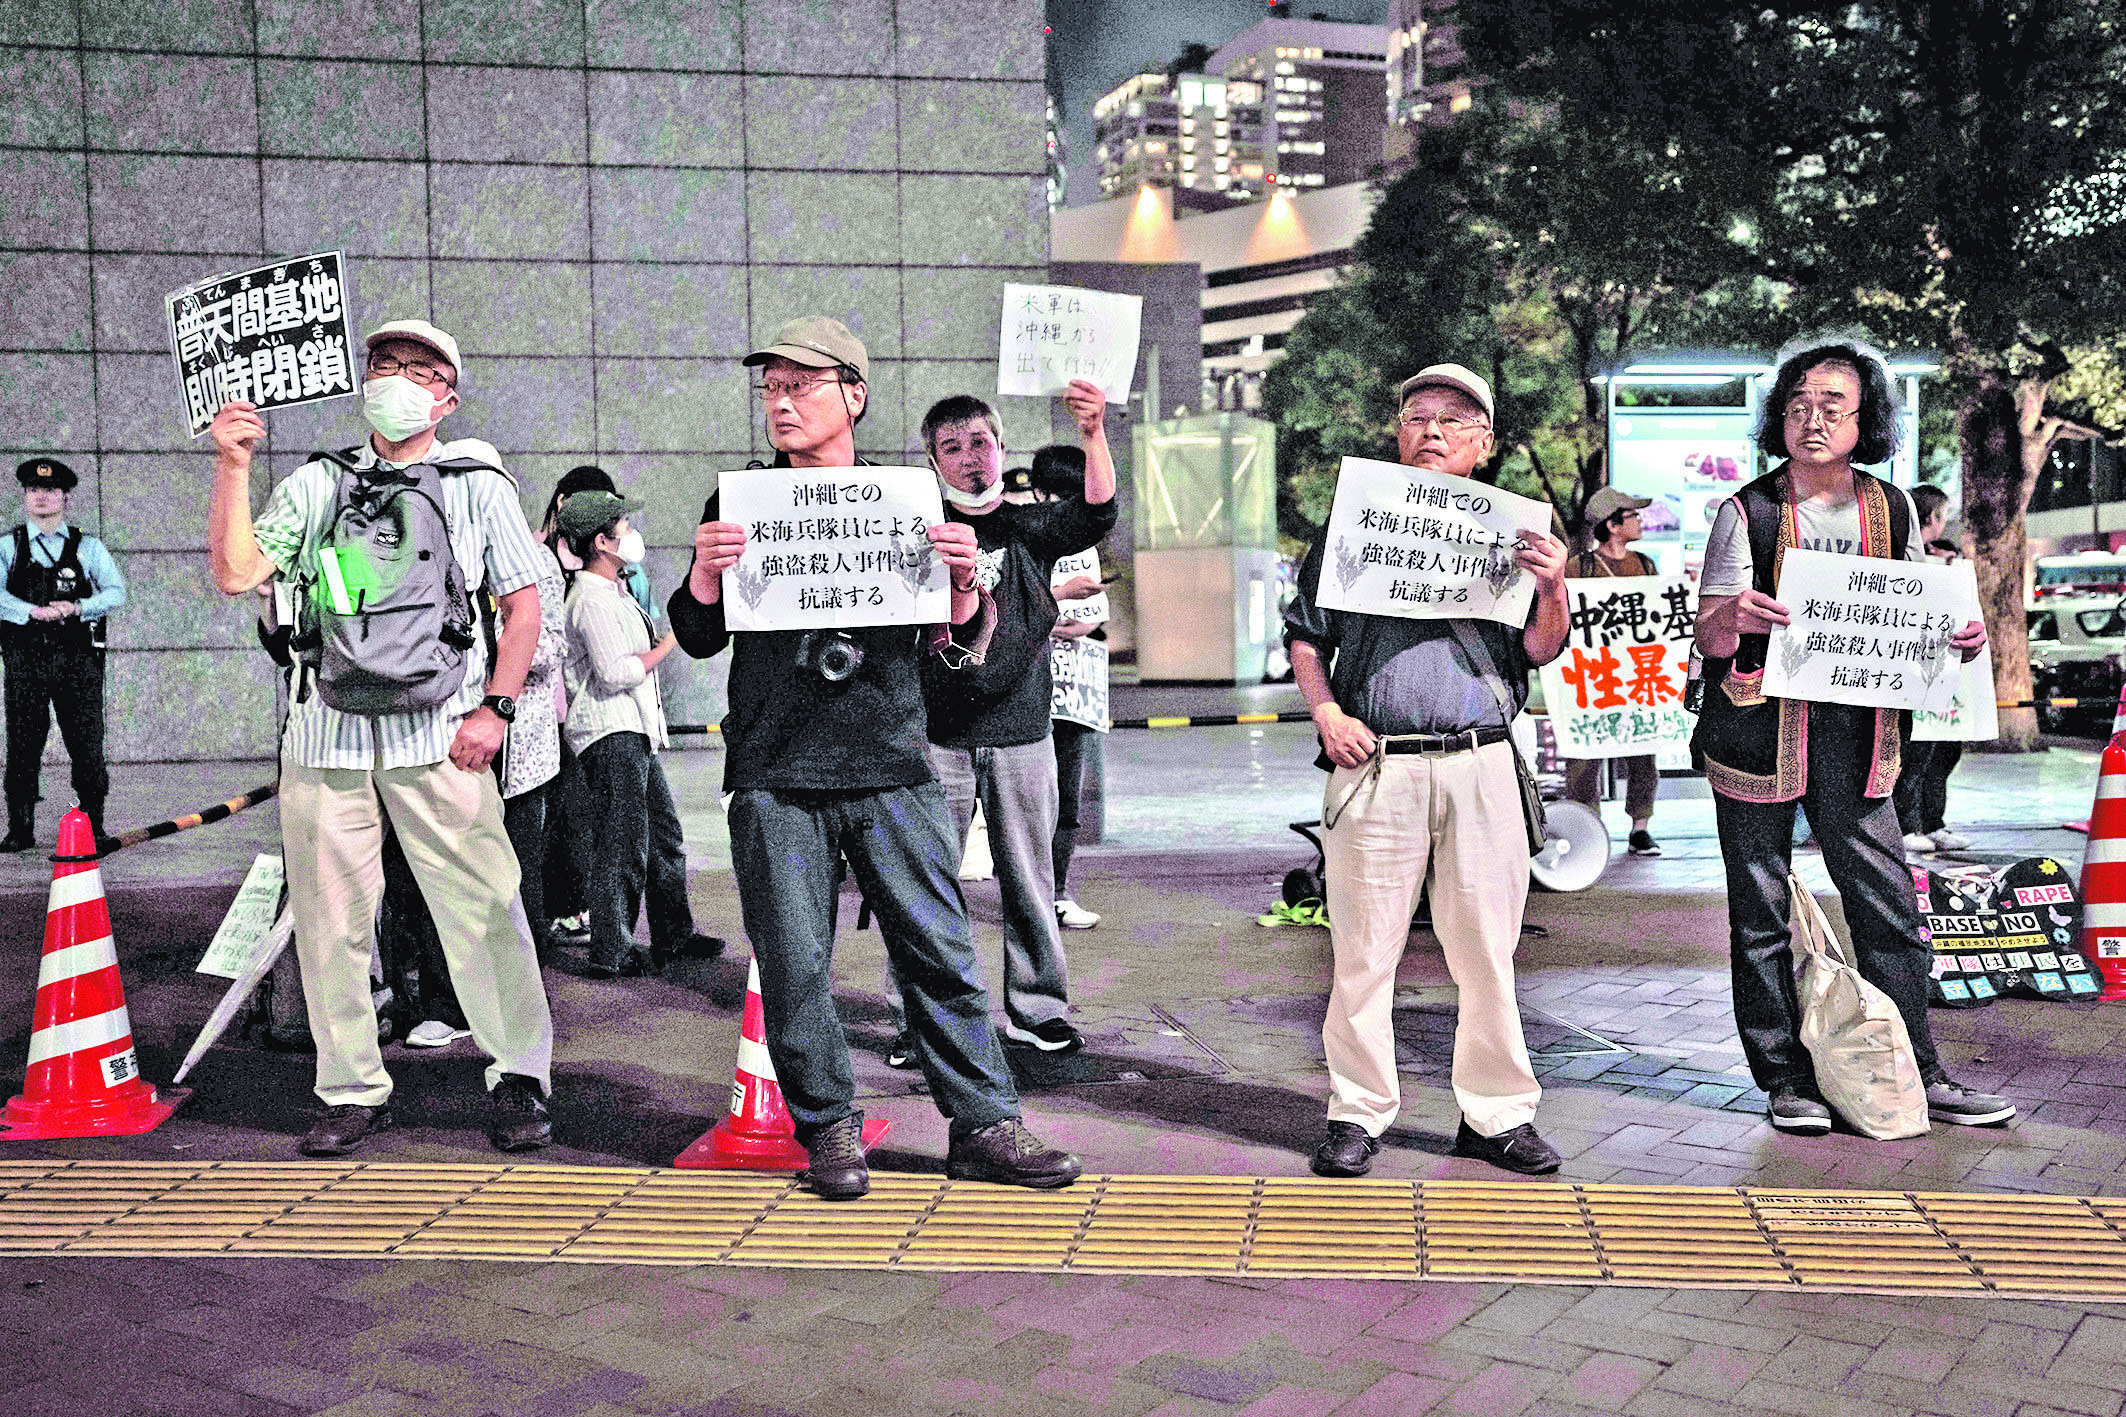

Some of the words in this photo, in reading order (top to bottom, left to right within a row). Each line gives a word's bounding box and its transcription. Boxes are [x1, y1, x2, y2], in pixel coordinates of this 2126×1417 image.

[1020, 292, 1085, 316] 米軍は
[1016, 320, 1096, 346] 沖縄から
[186, 334, 351, 429] 即時閉鎖
[792, 483, 882, 507] 沖縄での
[1405, 483, 1492, 515] 沖縄での
[750, 516, 927, 543] 米海兵隊員による
[1357, 508, 1531, 551] 米海兵隊員による
[762, 551, 918, 578] 強盗殺人事件に
[1053, 558, 1092, 574] 起こし
[1362, 543, 1511, 578] 強盗殺人事件に
[1389, 579, 1469, 604] 抗議する
[1848, 571, 1923, 597] 沖縄での
[799, 586, 884, 610] 抗議する
[1059, 605, 1102, 620] ください
[1801, 598, 1951, 632] 米海兵隊員による
[1806, 631, 1936, 662] 強盗殺人事件に
[1830, 665, 1904, 691] 抗議する
[2016, 885, 2071, 904] RAPE
[1929, 917, 1981, 933] BASE
[2004, 914, 2037, 931] NO
